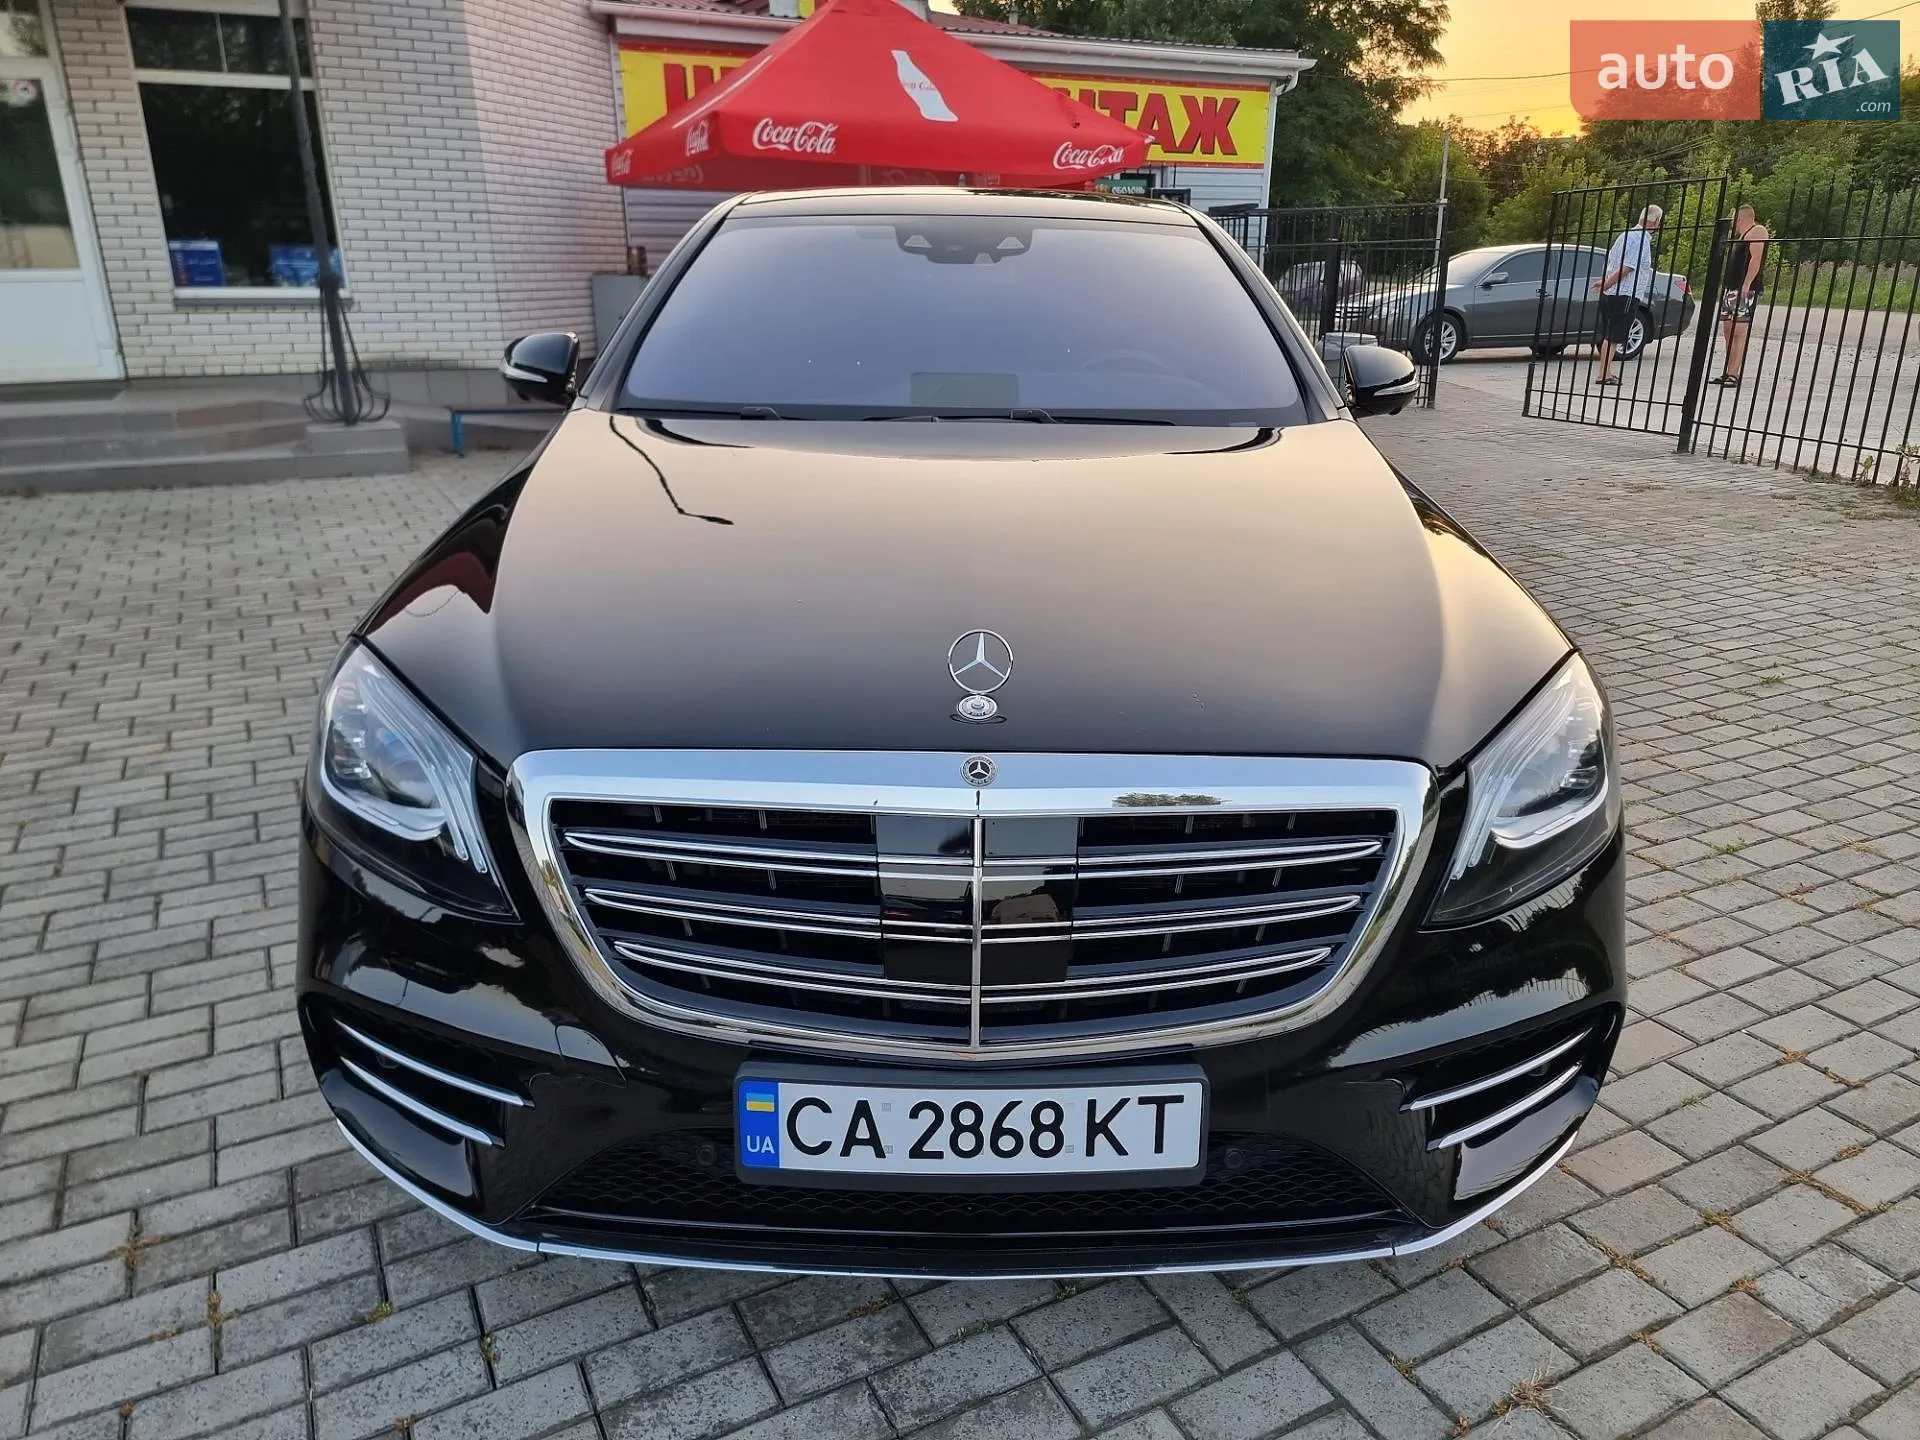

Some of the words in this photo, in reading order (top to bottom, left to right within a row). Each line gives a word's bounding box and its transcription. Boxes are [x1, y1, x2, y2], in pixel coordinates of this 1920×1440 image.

[752, 117, 839, 154] Coca-Cola
[746, 1135, 776, 1154] UA
[786, 1096, 887, 1159] CA
[908, 1099, 1065, 1160] 2868
[1085, 1094, 1185, 1157] KT
